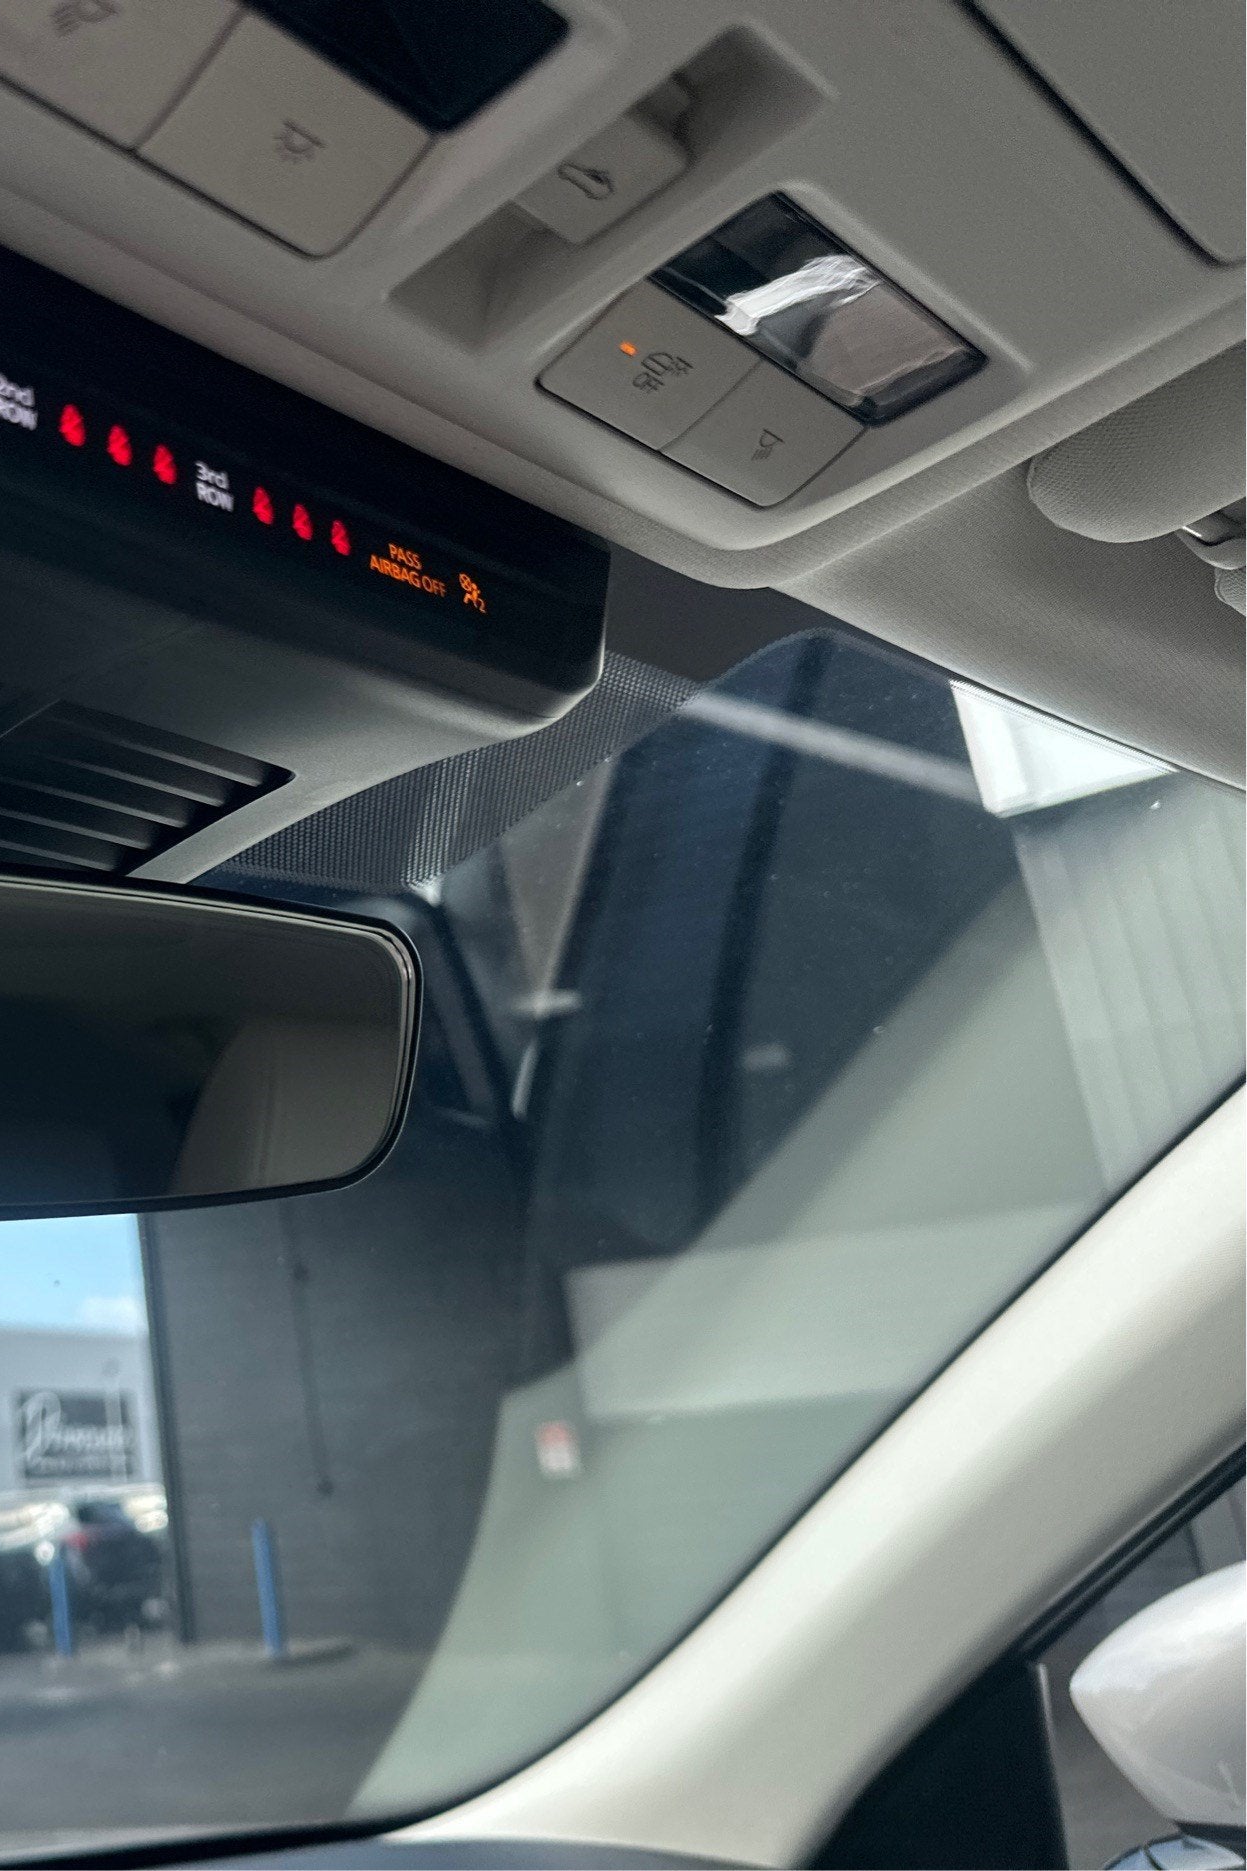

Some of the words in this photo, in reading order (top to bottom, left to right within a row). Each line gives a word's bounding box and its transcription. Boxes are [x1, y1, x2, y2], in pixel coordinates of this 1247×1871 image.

[195, 460, 229, 490] 3rd
[196, 481, 234, 513] ROW
[388, 542, 423, 571] PASS
[369, 553, 421, 589] AIRBAG
[421, 575, 446, 598] OFF
